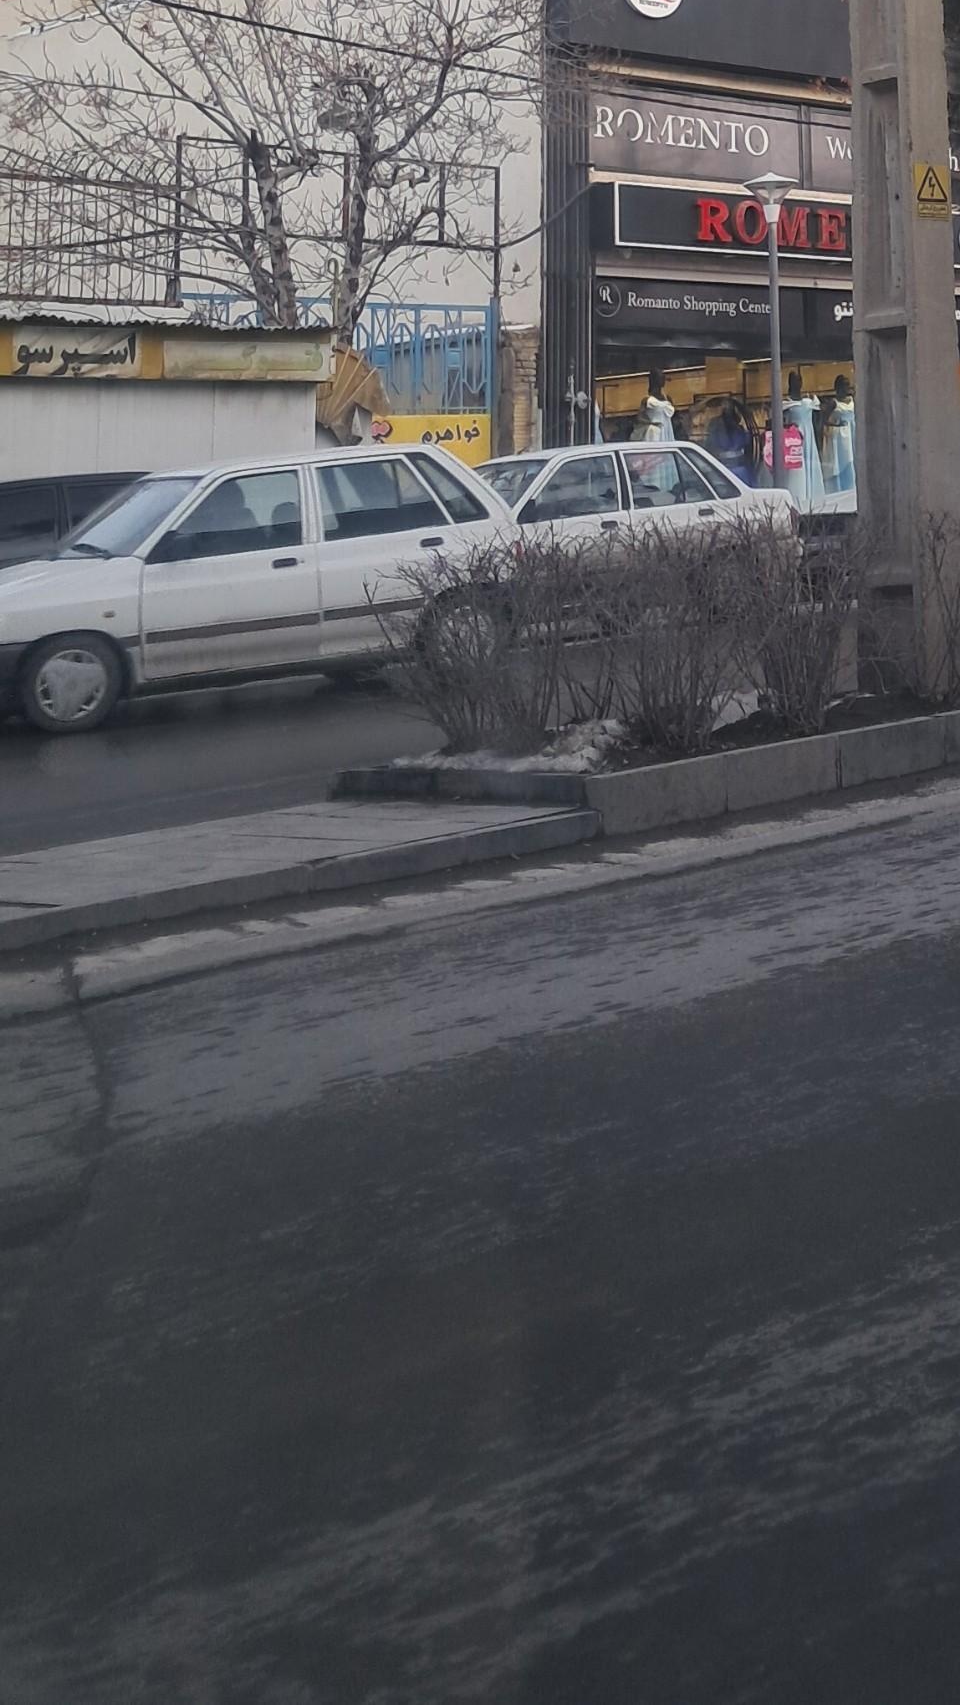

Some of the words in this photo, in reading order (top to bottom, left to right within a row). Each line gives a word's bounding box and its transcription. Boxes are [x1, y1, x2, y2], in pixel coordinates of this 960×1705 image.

[593, 105, 769, 156] ROMENTO
[695, 197, 847, 250] ROME
[627, 292, 680, 310] Romanto
[683, 294, 736, 317] Shopping
[739, 297, 772, 315] Cente
[12, 332, 136, 378] اسپرسو
[421, 420, 481, 444] خواهرم
